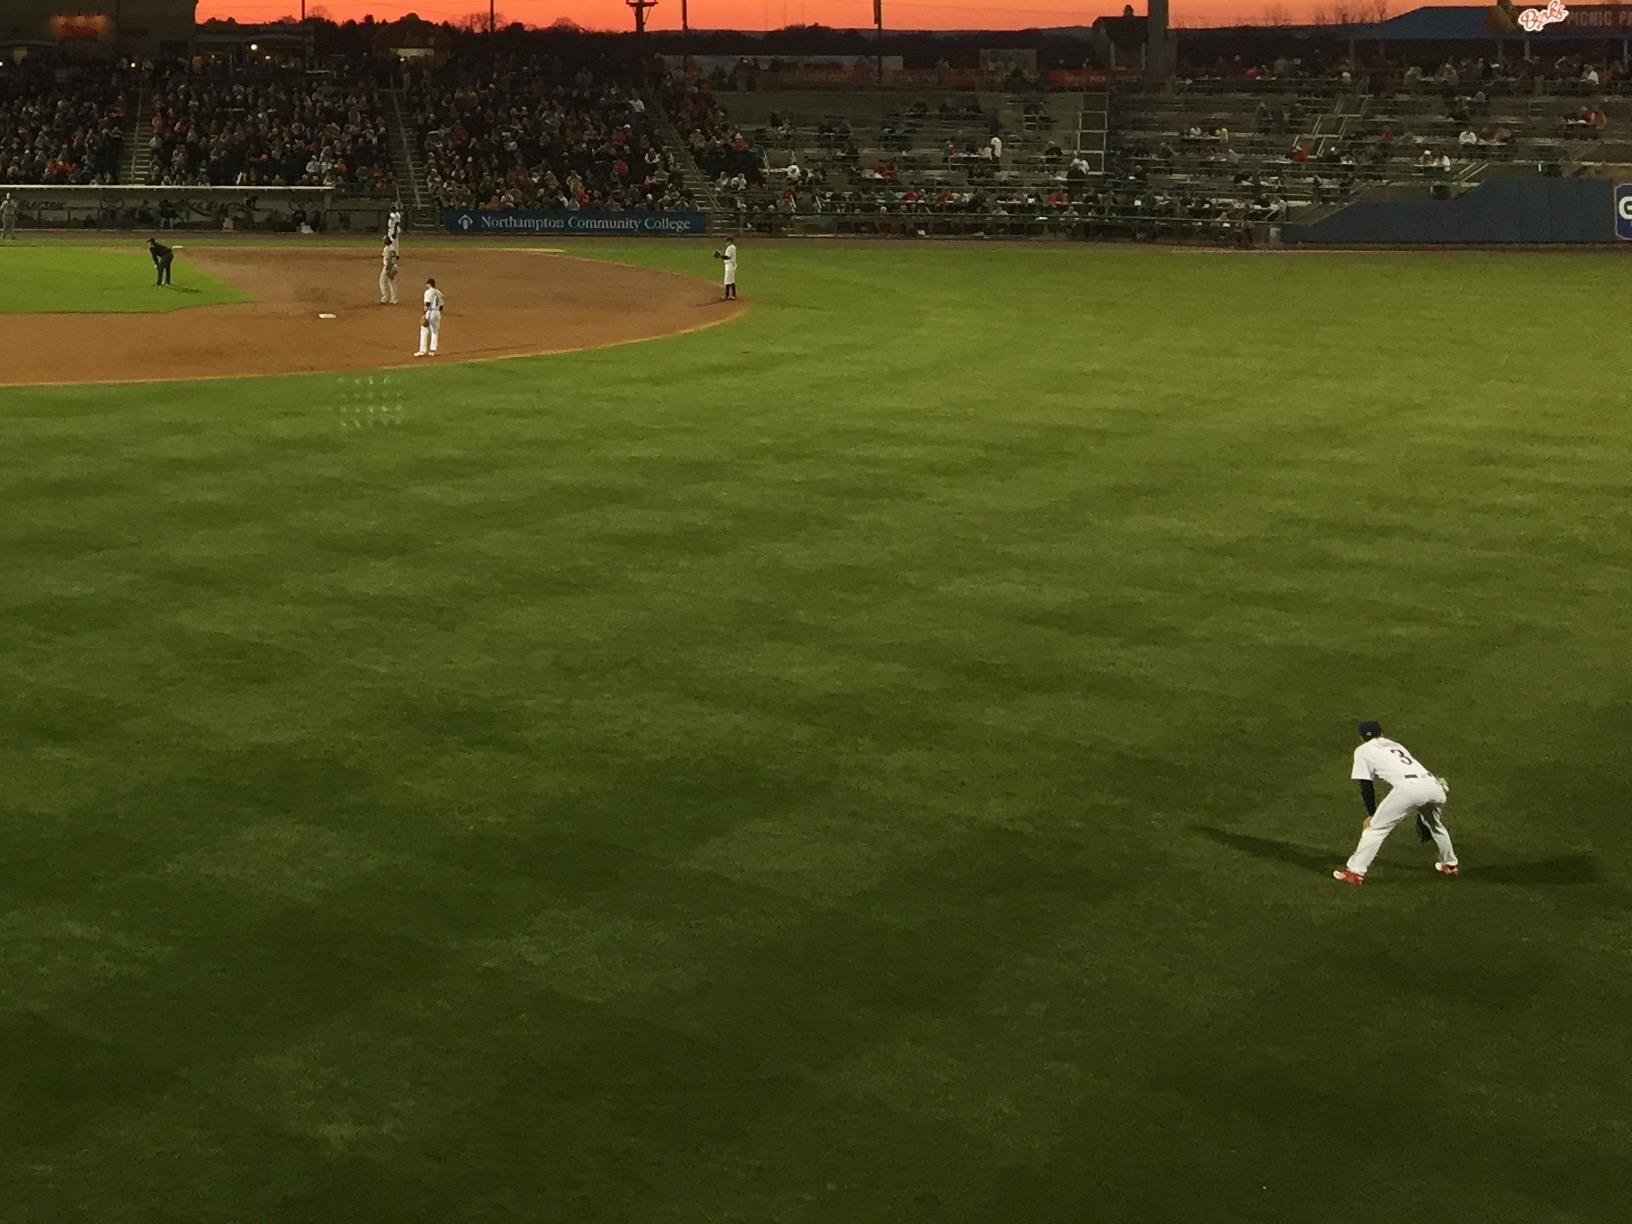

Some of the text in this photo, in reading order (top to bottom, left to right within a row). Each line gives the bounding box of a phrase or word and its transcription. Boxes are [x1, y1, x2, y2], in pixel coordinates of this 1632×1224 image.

[480, 216, 691, 231] Northampton Community College
[1390, 749, 1414, 765] 3
